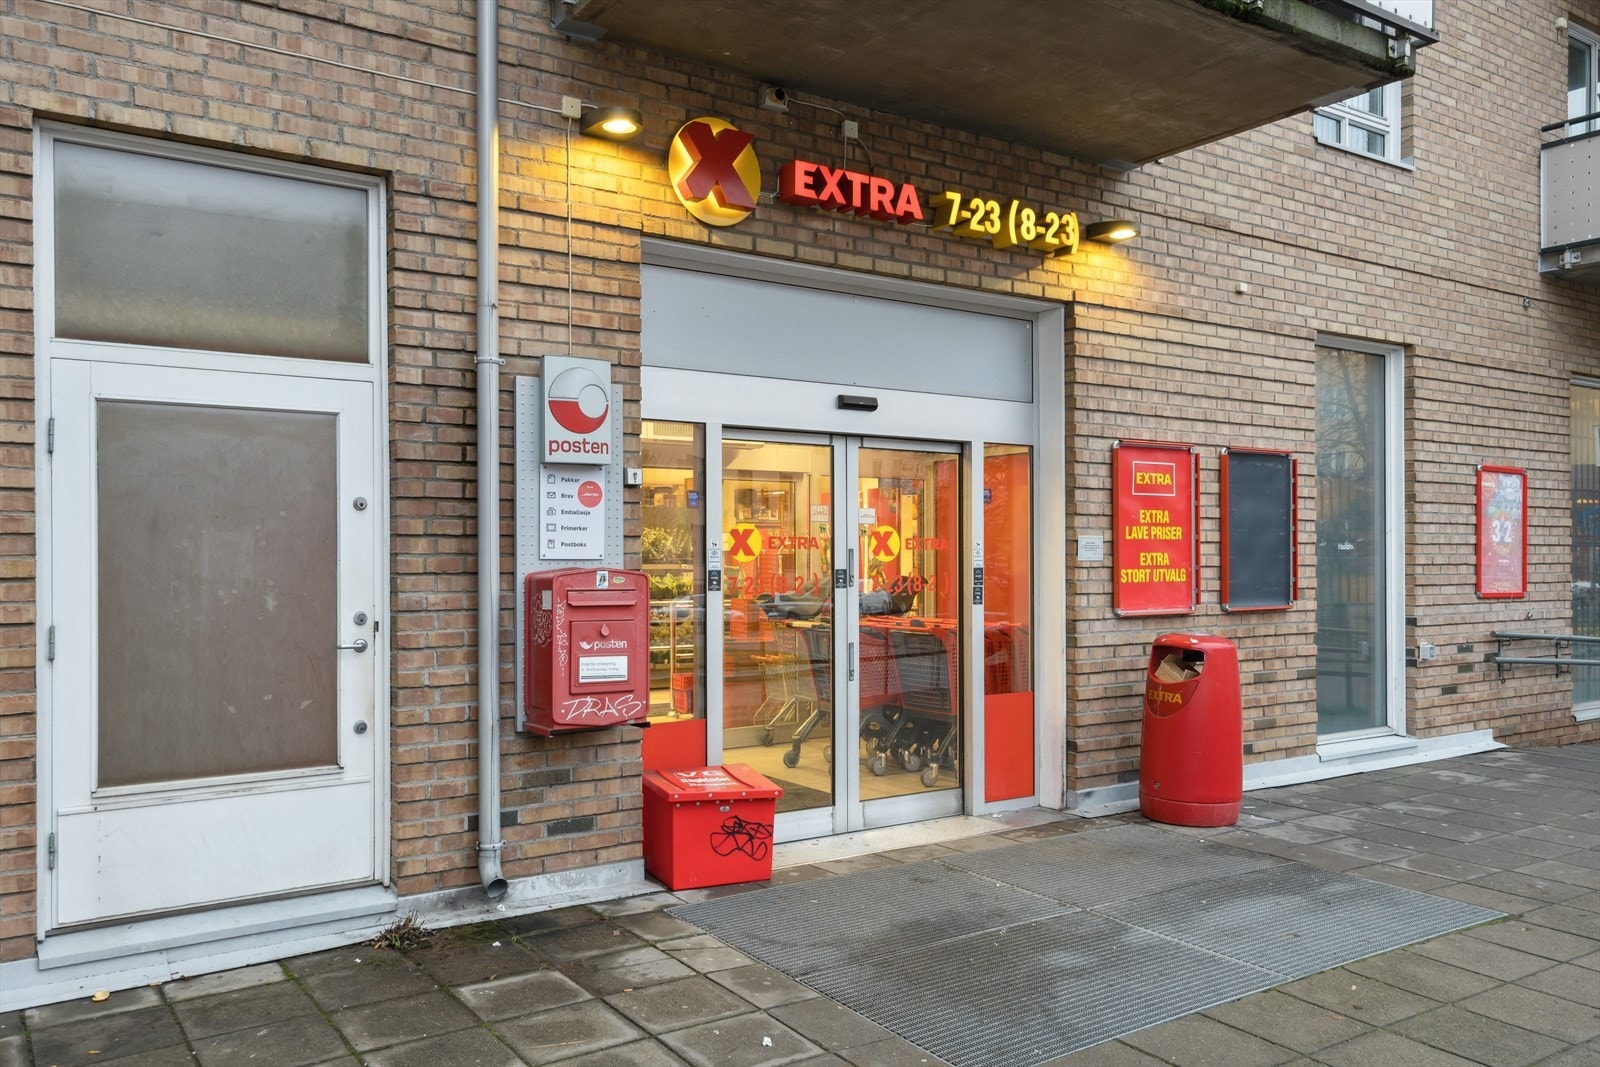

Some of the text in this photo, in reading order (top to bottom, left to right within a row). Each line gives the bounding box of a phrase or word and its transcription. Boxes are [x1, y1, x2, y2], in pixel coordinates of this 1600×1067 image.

[793, 160, 923, 221] EXTRA
[946, 191, 1080, 254] 7-23 (8-23)
[548, 437, 609, 455] posten
[561, 476, 581, 484] Pakker
[1136, 472, 1172, 486] EXTRA
[561, 492, 574, 500] Brev
[561, 508, 591, 517] Emballasje
[1139, 509, 1170, 524] EXTRA
[561, 524, 588, 532] Frimerker
[1125, 526, 1182, 540] LAVE PRISER
[561, 540, 587, 548] Postboks
[768, 536, 819, 550] EXTRA
[905, 538, 949, 551] EXTRA
[1139, 552, 1170, 566] EXTRA
[1120, 568, 1187, 583] STORT UTVALG
[593, 639, 628, 651] posten
[1148, 689, 1183, 705] EXTRA
